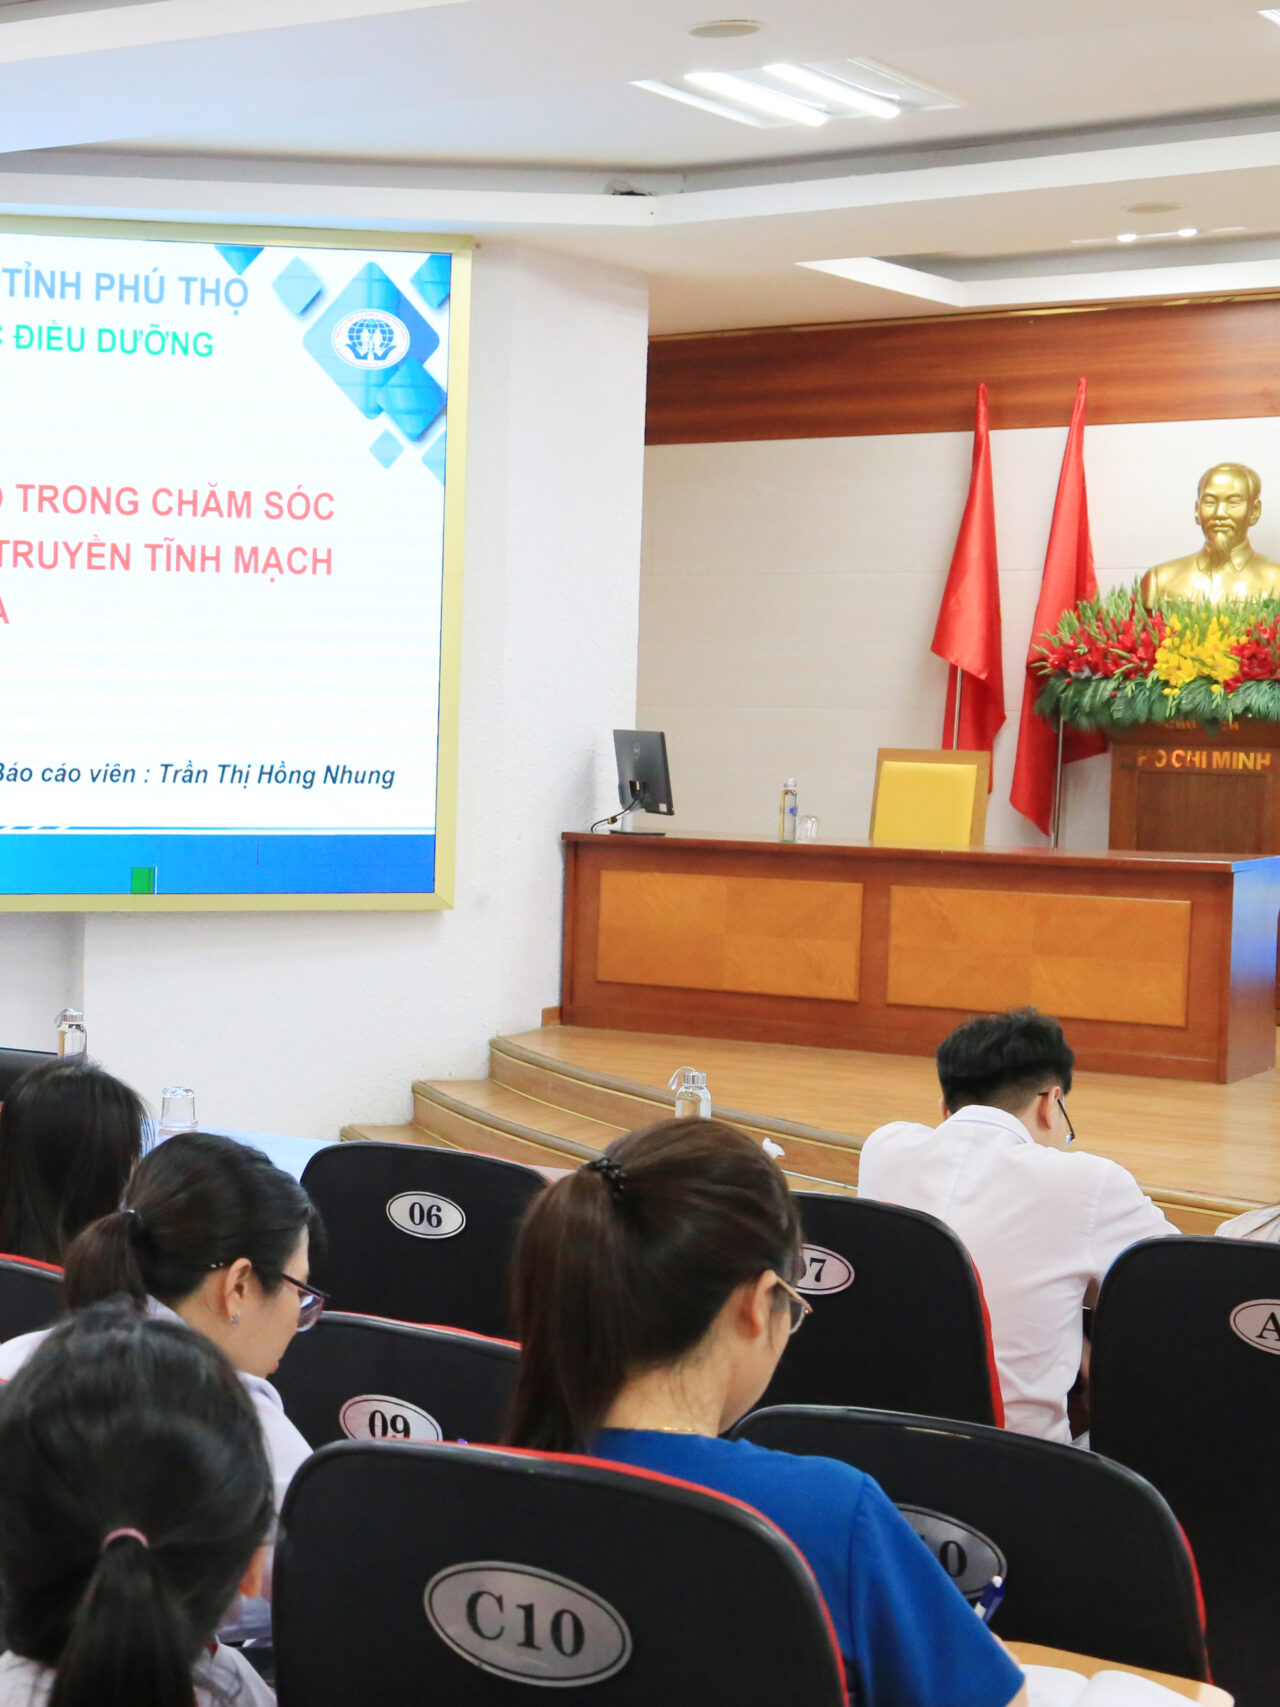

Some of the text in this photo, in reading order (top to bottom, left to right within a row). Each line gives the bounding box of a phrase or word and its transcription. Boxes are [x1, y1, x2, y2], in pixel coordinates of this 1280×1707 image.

[2, 261, 81, 300] TỈNH
[95, 267, 165, 304] PHÚ
[178, 278, 248, 316] THỌ
[97, 323, 213, 358] DƯỠNG
[16, 484, 138, 515] TRONG
[152, 482, 251, 518] CHĂM
[264, 485, 334, 520] SÓC
[144, 537, 220, 573] TĨNH
[235, 546, 332, 582] MẠCH
[41, 762, 81, 783] cáo
[90, 763, 136, 783] viên
[160, 760, 208, 784] Trần
[218, 763, 252, 789] Thị
[258, 760, 316, 790] Hồng
[323, 764, 395, 790] Nhung
[1171, 749, 1208, 769] CHI
[1211, 751, 1272, 770] MINH
[409, 1202, 443, 1228] 06
[809, 1257, 827, 1283] 7
[1255, 1312, 1280, 1342] A
[368, 1410, 411, 1439] 09
[934, 1538, 967, 1578] 0
[466, 1590, 585, 1658] C10
